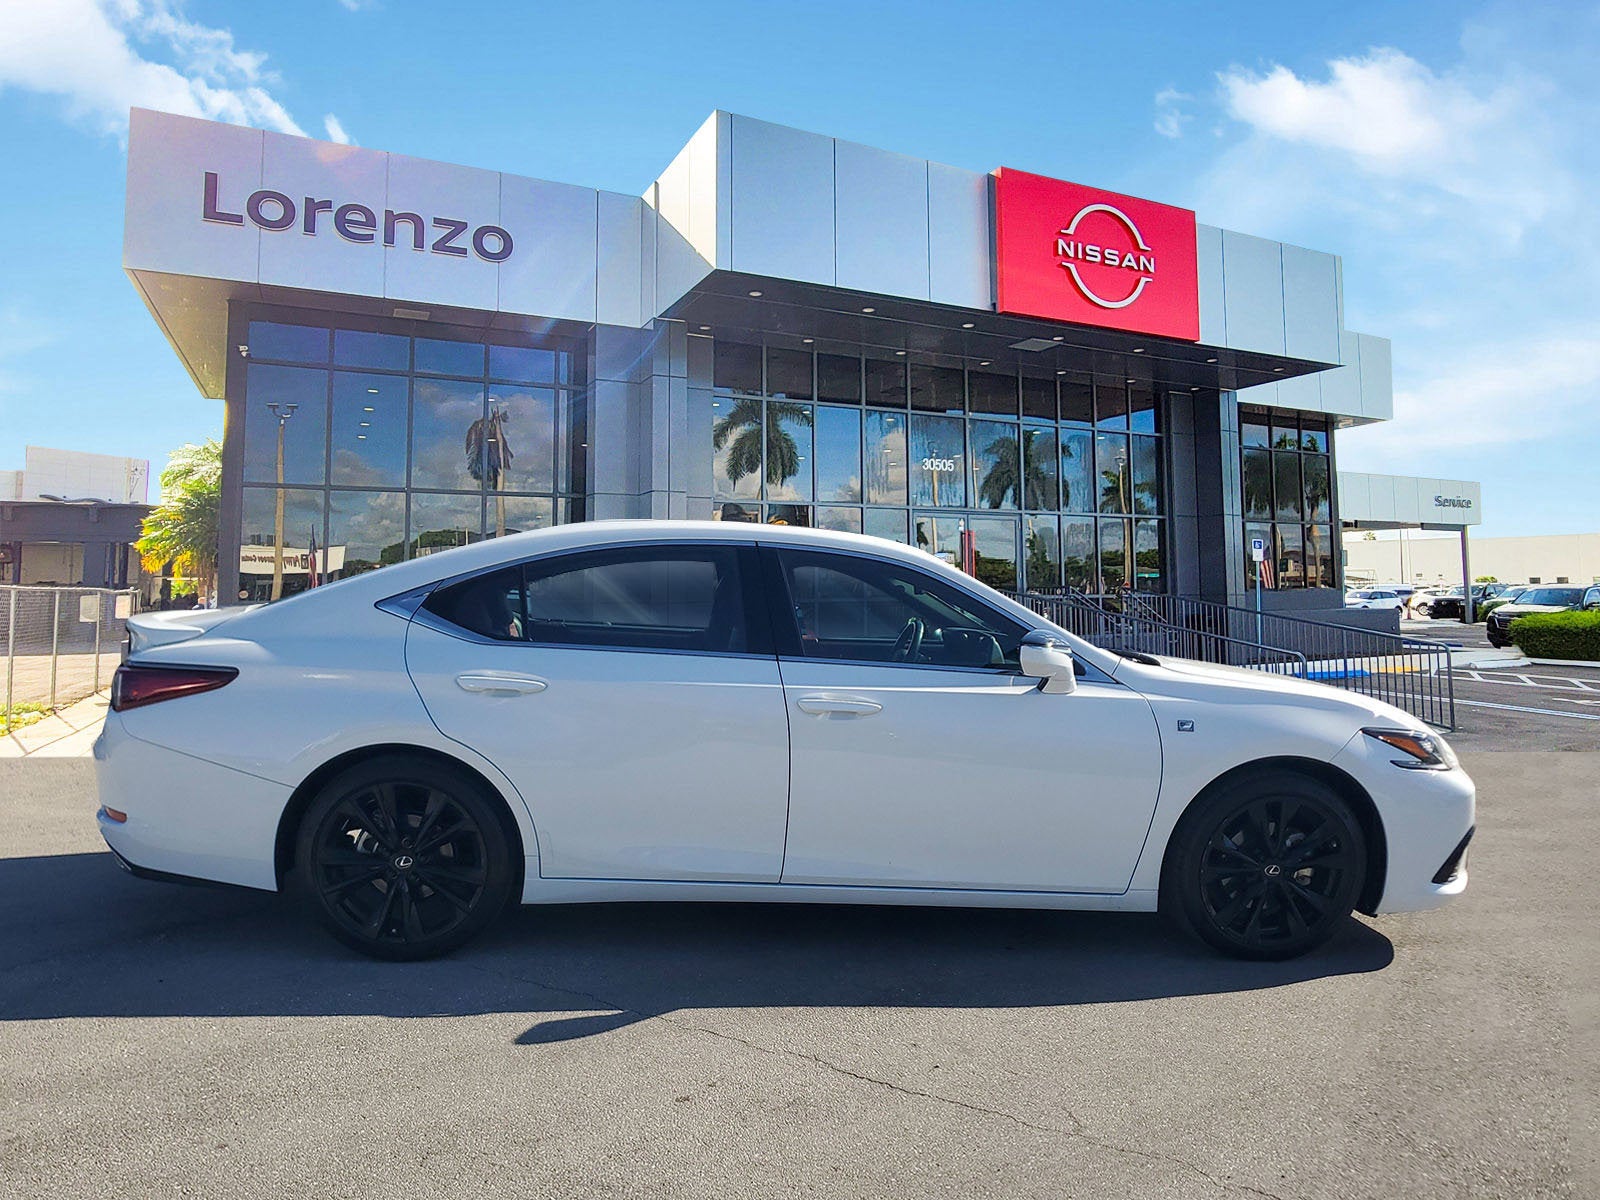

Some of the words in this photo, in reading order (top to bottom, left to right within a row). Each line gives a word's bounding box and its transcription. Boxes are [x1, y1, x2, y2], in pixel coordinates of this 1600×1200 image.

[202, 171, 514, 262] Lorenzo
[1057, 239, 1155, 273] NISSAN
[922, 458, 955, 472] 30505
[1434, 495, 1472, 508] Service
